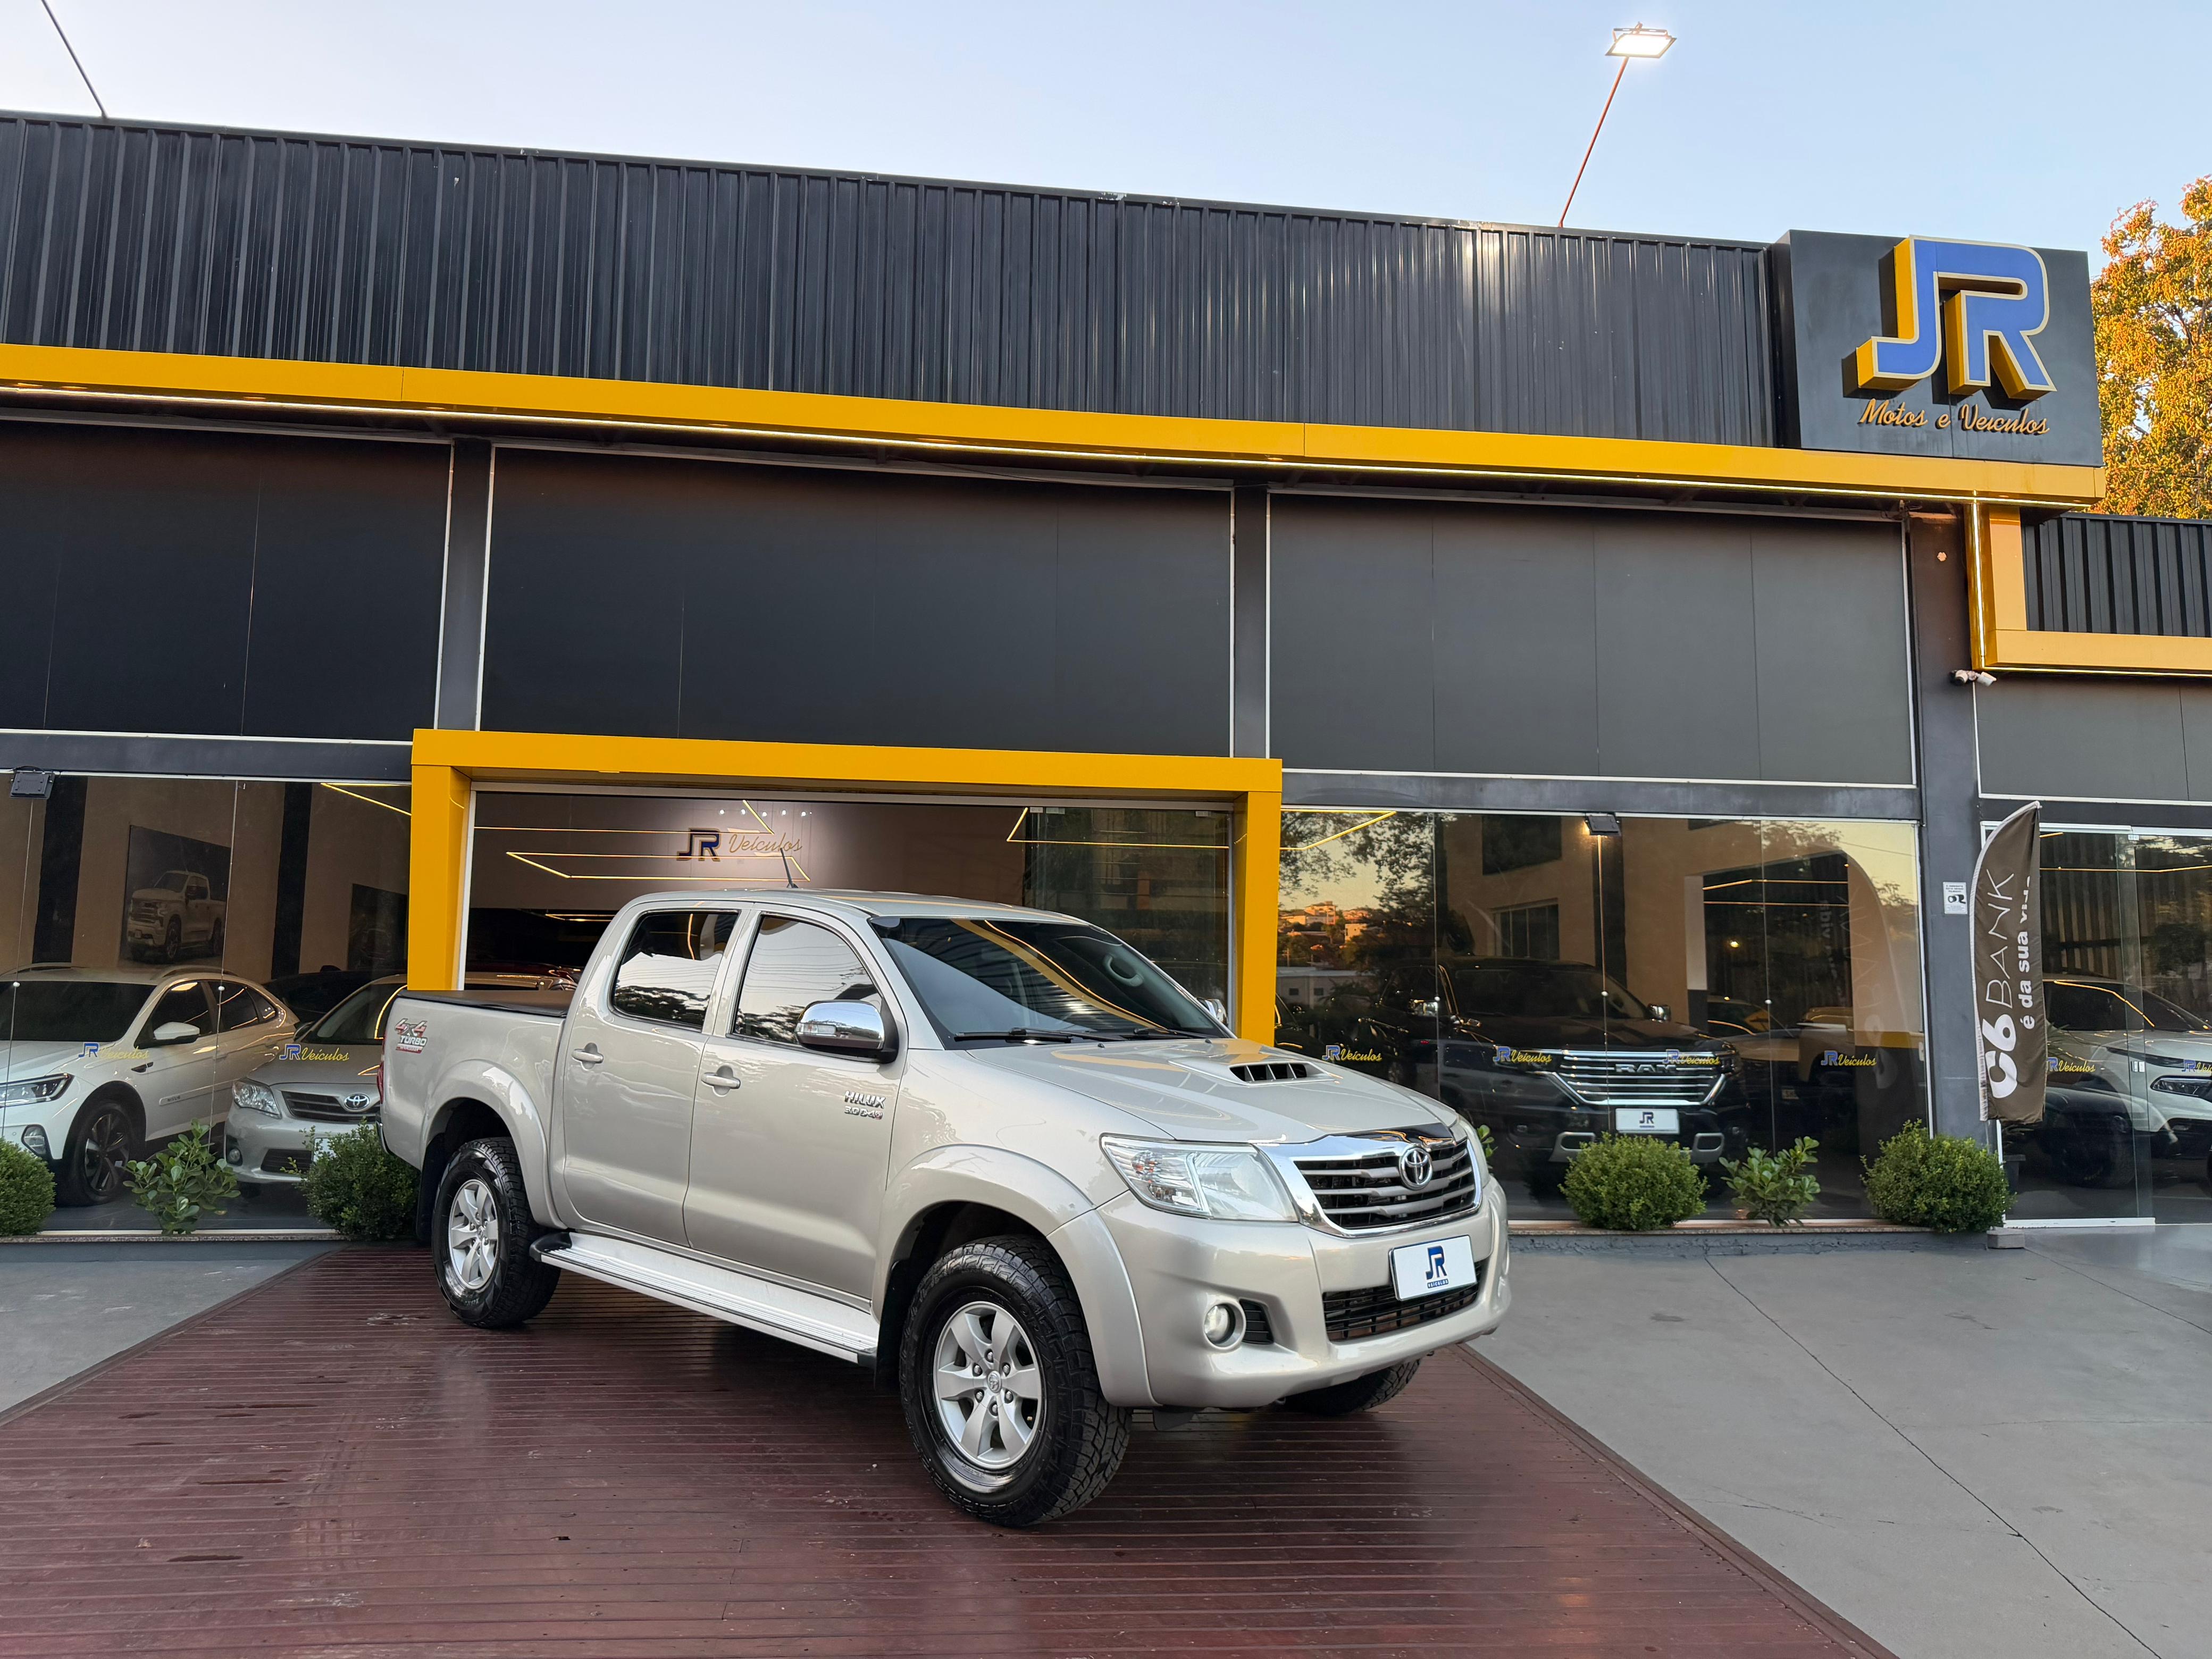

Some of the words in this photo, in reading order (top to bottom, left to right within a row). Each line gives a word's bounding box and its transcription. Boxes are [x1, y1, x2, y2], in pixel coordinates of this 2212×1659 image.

[1857, 234, 2057, 398] JR
[1859, 398, 1928, 427] Motos
[1935, 412, 1951, 428] e
[676, 828, 722, 862] JR
[1985, 869, 2014, 1009] BANK
[2017, 931, 2030, 973] sua
[2018, 980, 2033, 1008] da
[2020, 1015, 2035, 1030] é
[400, 1035, 428, 1046] TURBO
[78, 1042, 99, 1058] JR
[279, 1044, 301, 1060] JR
[301, 1047, 350, 1061] Veículos
[1322, 1045, 1340, 1060] JR
[1493, 1046, 1511, 1062] JR
[1662, 1049, 1680, 1064] JR
[1821, 1050, 1838, 1066] JR
[1982, 1013, 2018, 1099] C6
[1615, 1063, 1677, 1073] RAM
[2181, 1059, 2197, 1073] JR
[844, 1091, 886, 1109] HILUX
[1639, 1111, 1654, 1124] JR
[1426, 1245, 1447, 1280] JR
